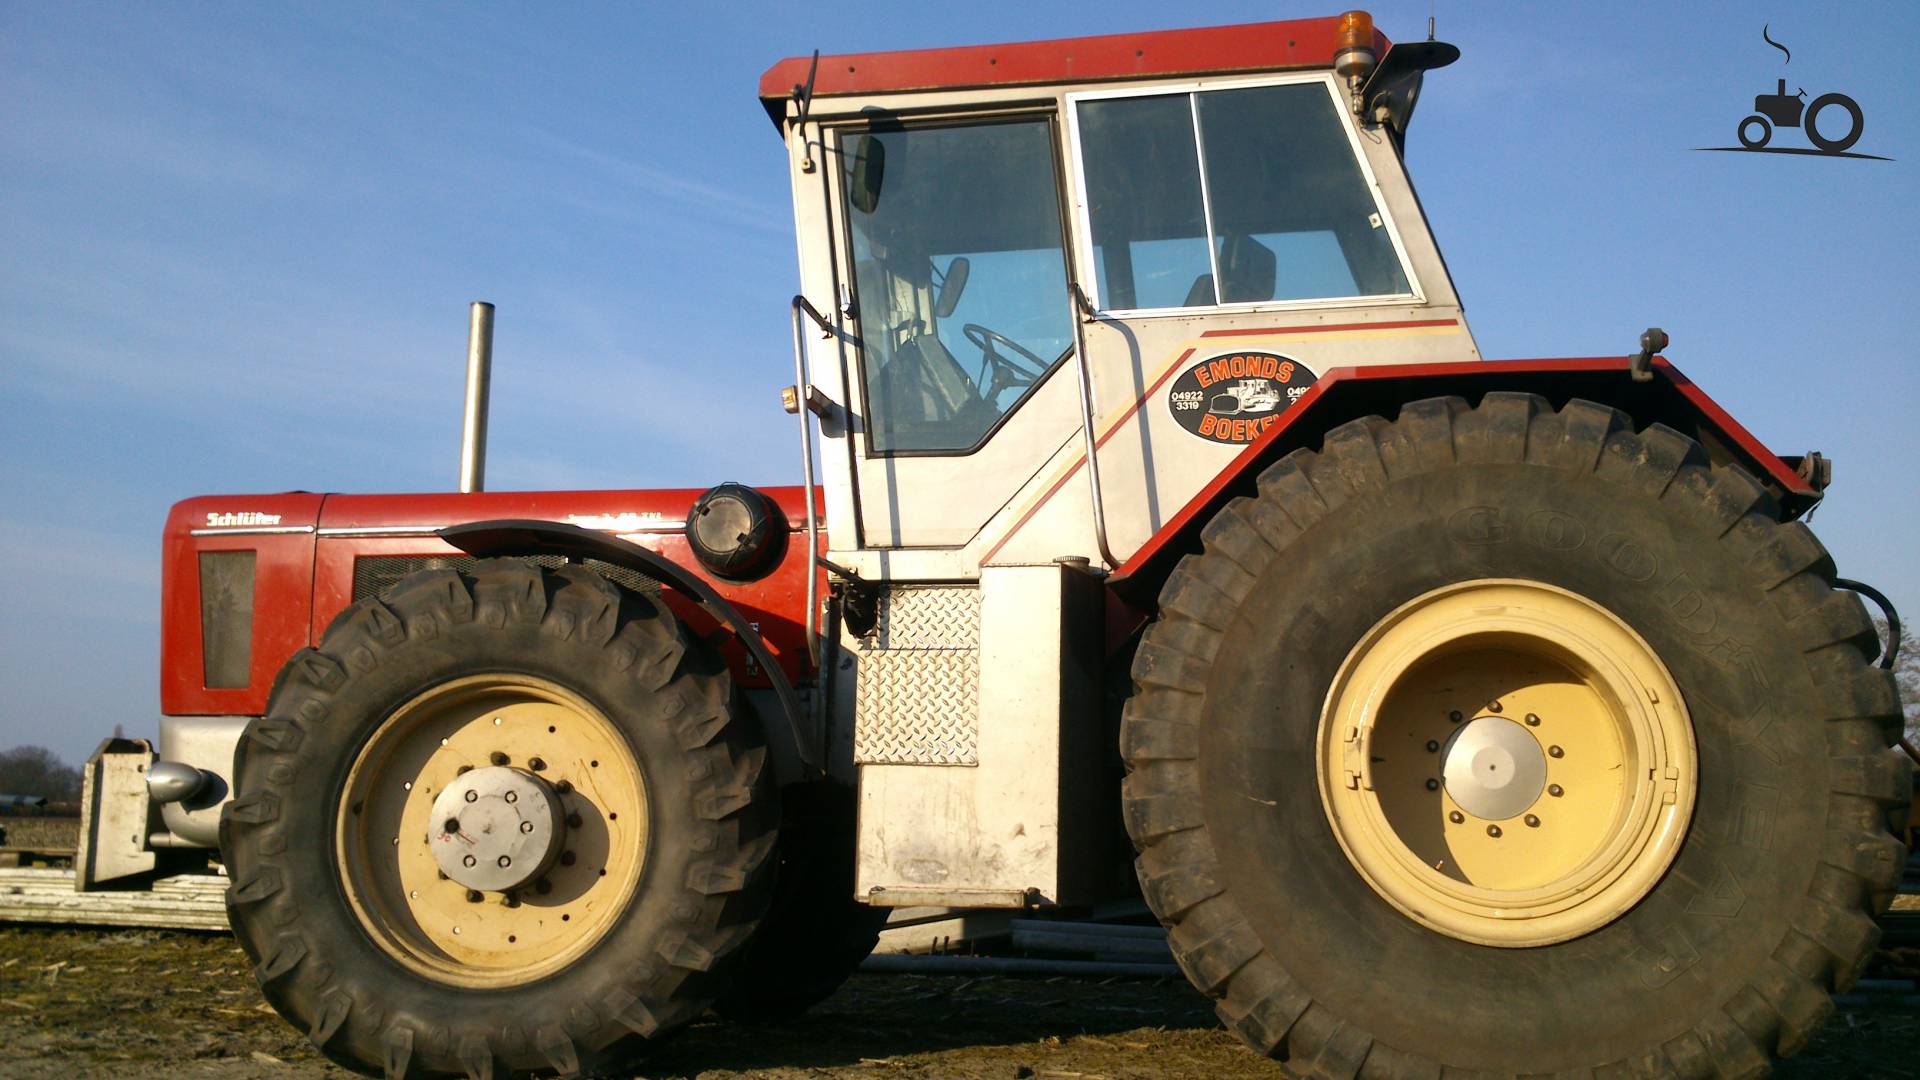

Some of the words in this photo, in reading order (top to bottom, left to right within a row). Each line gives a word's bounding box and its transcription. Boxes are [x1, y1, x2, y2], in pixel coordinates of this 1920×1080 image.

[1194, 356, 1294, 388] EMONDS
[1171, 391, 1204, 401] 04922
[1176, 402, 1200, 411] 3319
[1199, 413, 1280, 440] BOEKE
[206, 512, 282, 526] Schlüter
